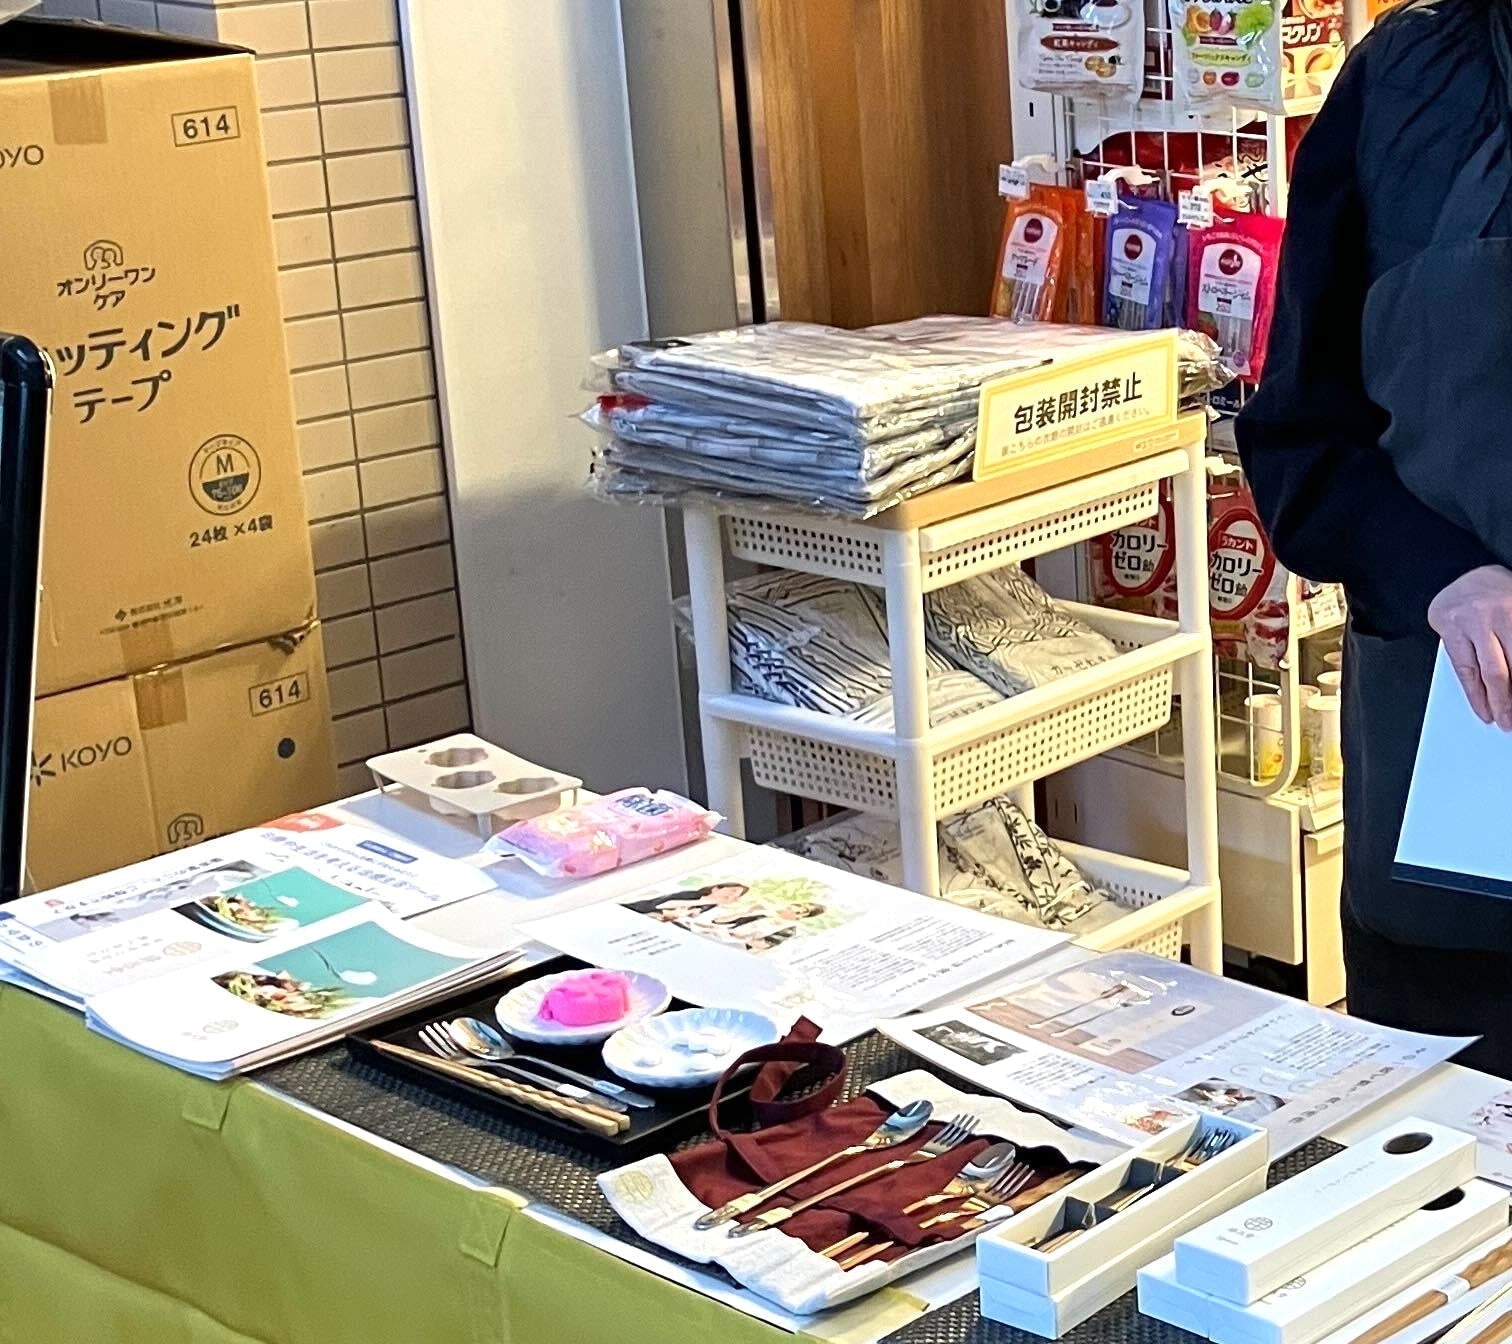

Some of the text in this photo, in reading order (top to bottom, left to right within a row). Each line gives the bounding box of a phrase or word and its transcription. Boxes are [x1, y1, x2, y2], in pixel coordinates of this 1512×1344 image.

[183, 113, 231, 140] 614
[0, 144, 44, 168] YO
[57, 267, 155, 297] オンリーワン
[93, 290, 126, 311] ケア
[44, 303, 240, 376] ッティング
[73, 369, 172, 424] テープ
[1014, 371, 1143, 435] 包装開封禁止
[216, 453, 235, 475] M
[1111, 531, 1168, 553] カロリー
[1210, 552, 1263, 576] カロリー
[259, 679, 301, 709] 614
[61, 735, 132, 773] KOYO
